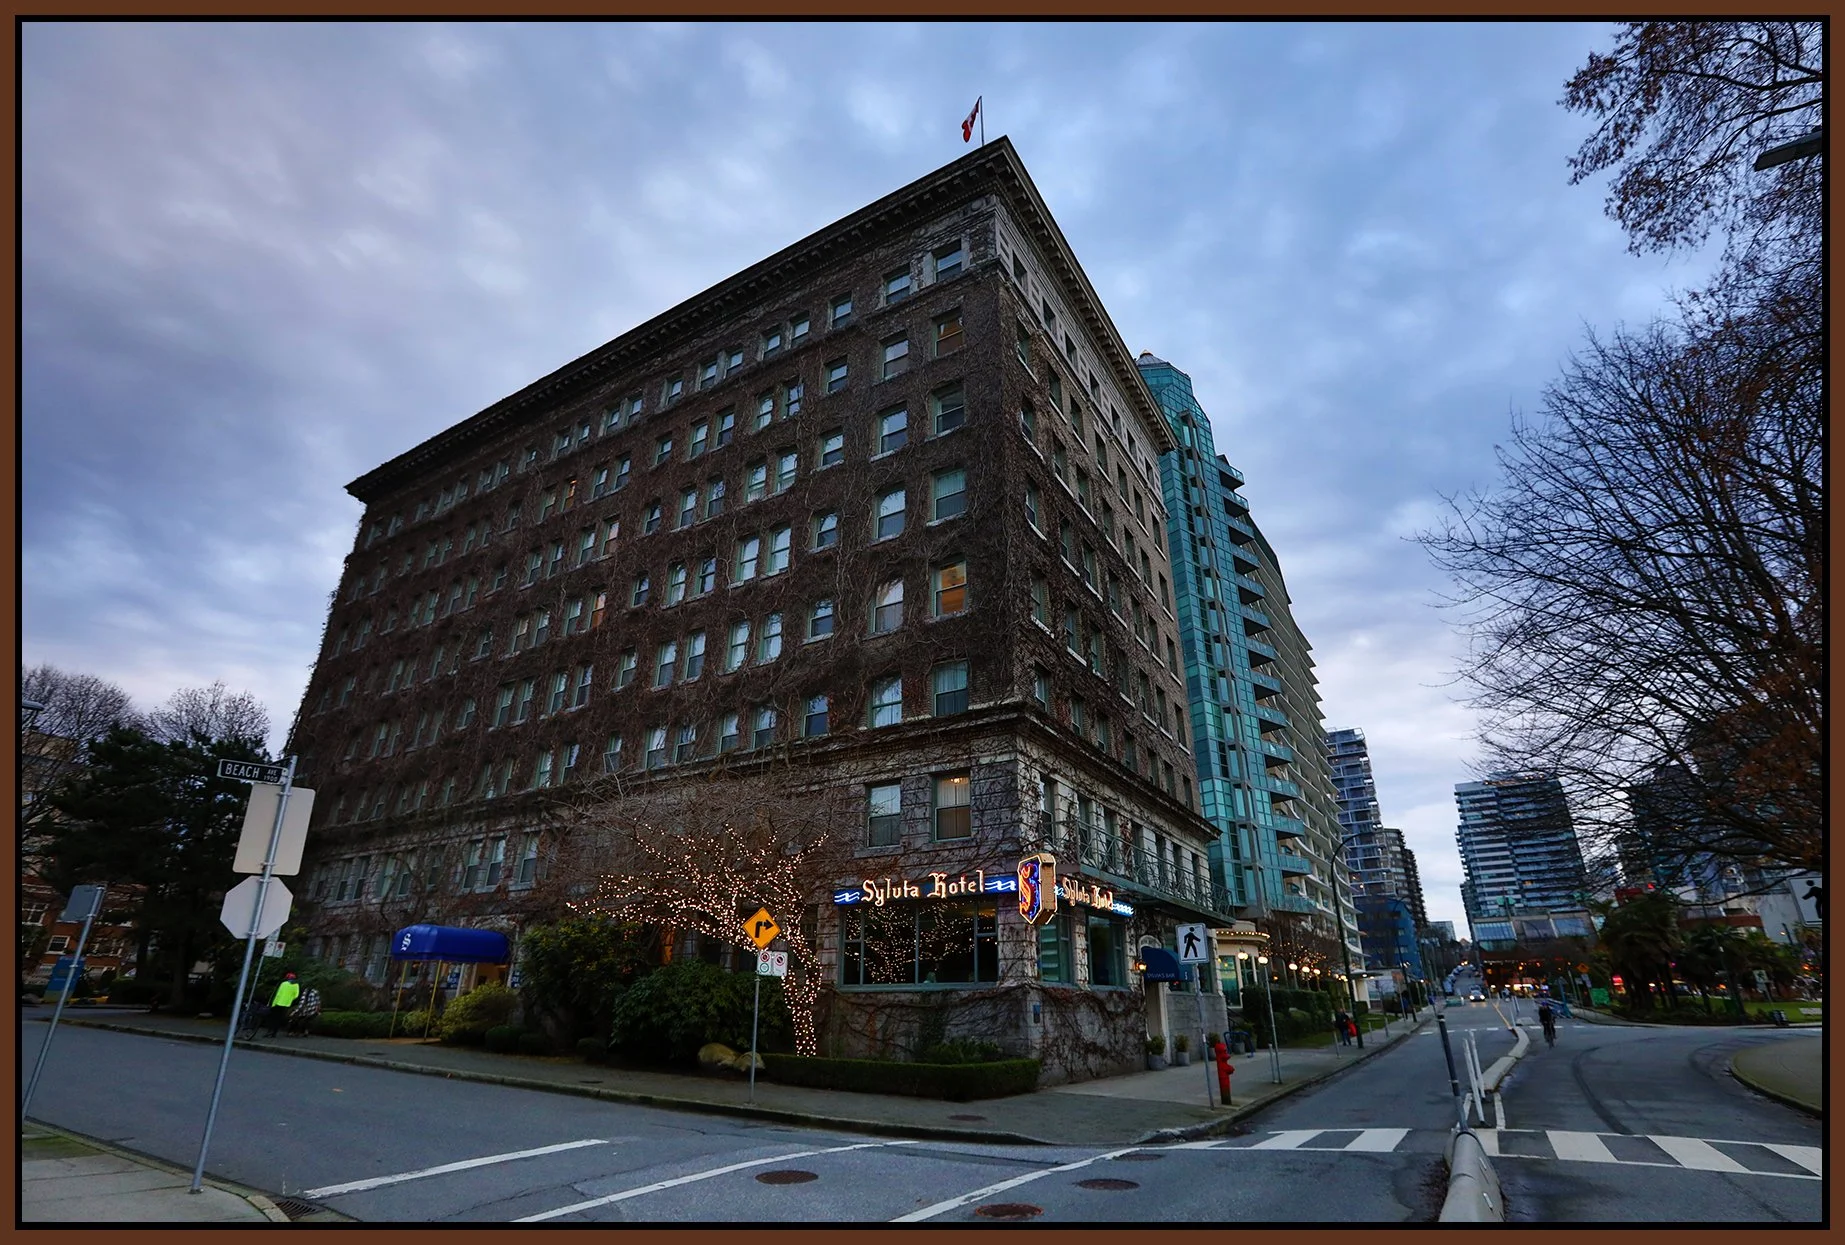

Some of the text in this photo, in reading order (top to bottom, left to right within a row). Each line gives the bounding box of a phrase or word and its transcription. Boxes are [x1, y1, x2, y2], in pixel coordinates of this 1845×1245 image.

[225, 764, 260, 778] BEACH
[861, 870, 984, 907] Sylvia Hotel
